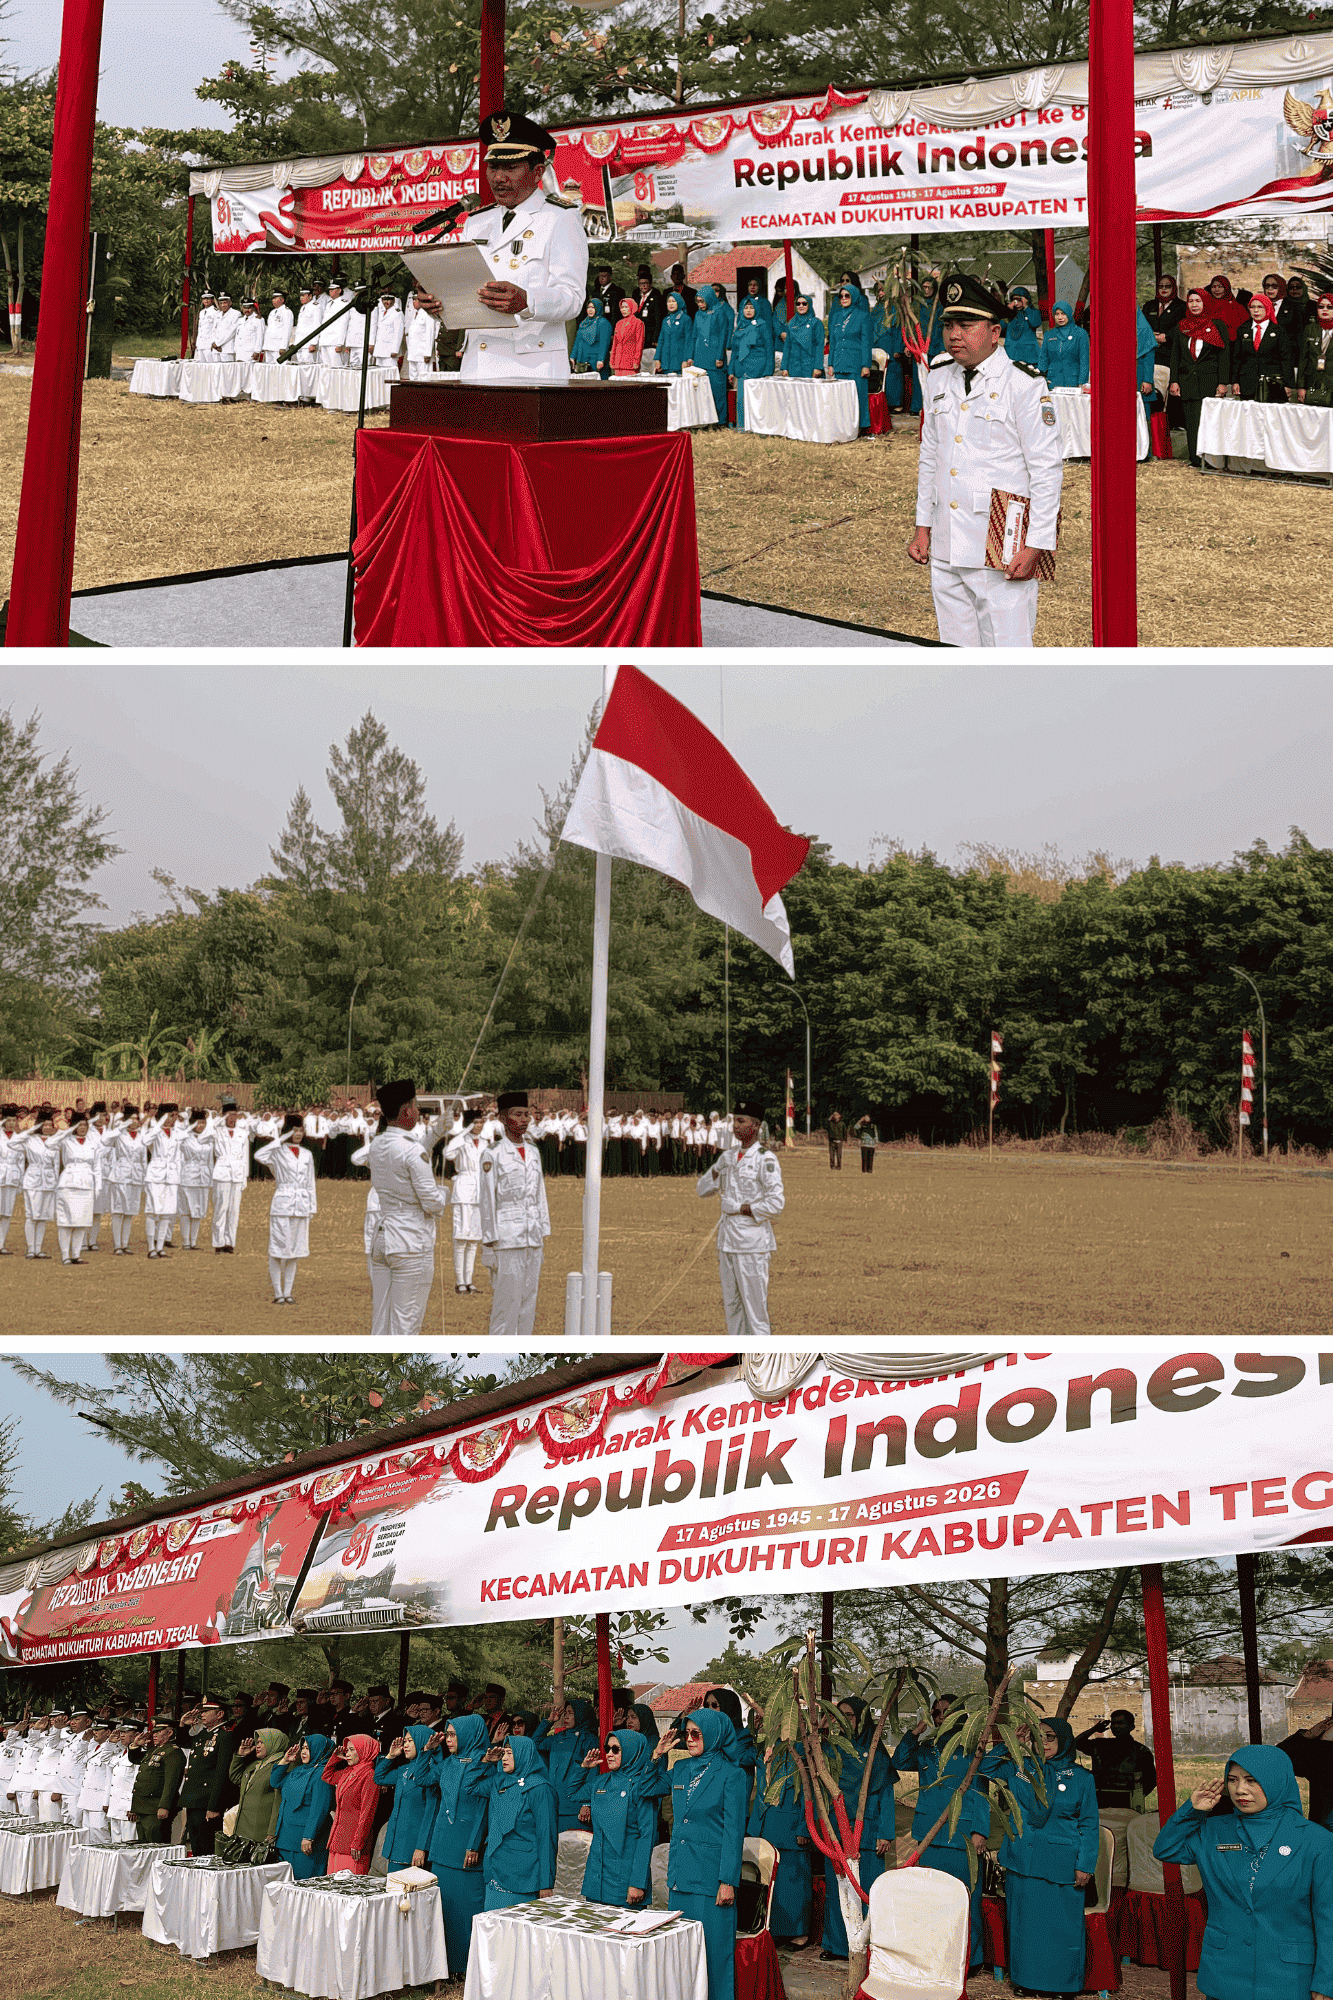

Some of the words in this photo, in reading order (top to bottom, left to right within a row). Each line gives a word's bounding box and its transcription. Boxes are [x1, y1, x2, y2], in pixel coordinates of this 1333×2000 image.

[1230, 89, 1261, 101] APIK
[1037, 107, 1064, 125] ke
[1071, 105, 1085, 121] 8
[733, 144, 904, 191] Republik
[917, 130, 1153, 174] Indonea
[322, 185, 397, 212] REPUBLIK
[401, 178, 480, 204] INDONESI
[848, 194, 858, 202] 17
[859, 192, 894, 202] Agustus
[896, 191, 917, 200] 1945
[924, 189, 934, 197] 17
[935, 187, 971, 199] Agustus
[973, 186, 997, 195] 2026
[741, 211, 836, 229] KECAMATAN
[842, 205, 944, 224] DUKUHTURI
[950, 199, 1067, 219] KABUPATEN
[305, 238, 359, 250] KECAMATAN
[484, 1429, 798, 1532] Republik
[824, 1353, 1333, 1478] Indones
[380, 1521, 406, 1532] INDONESIA
[675, 1527, 695, 1542] 17
[698, 1516, 761, 1541] Agustus
[765, 1510, 812, 1529] 1945
[829, 1506, 851, 1522] 17
[855, 1494, 938, 1521] Agustus
[943, 1481, 1001, 1504] 2026
[481, 1561, 649, 1603] KECAMATAN
[658, 1535, 867, 1585] DUKUHTURI
[881, 1490, 1191, 1561] KABUPATEN
[1209, 1471, 1333, 1521] TEG
[22, 1645, 57, 1661] KECAMATAN
[59, 1637, 104, 1656] DUKUHTURI
[105, 1629, 163, 1650] KABUPATEN
[166, 1623, 199, 1643] TEGAL
